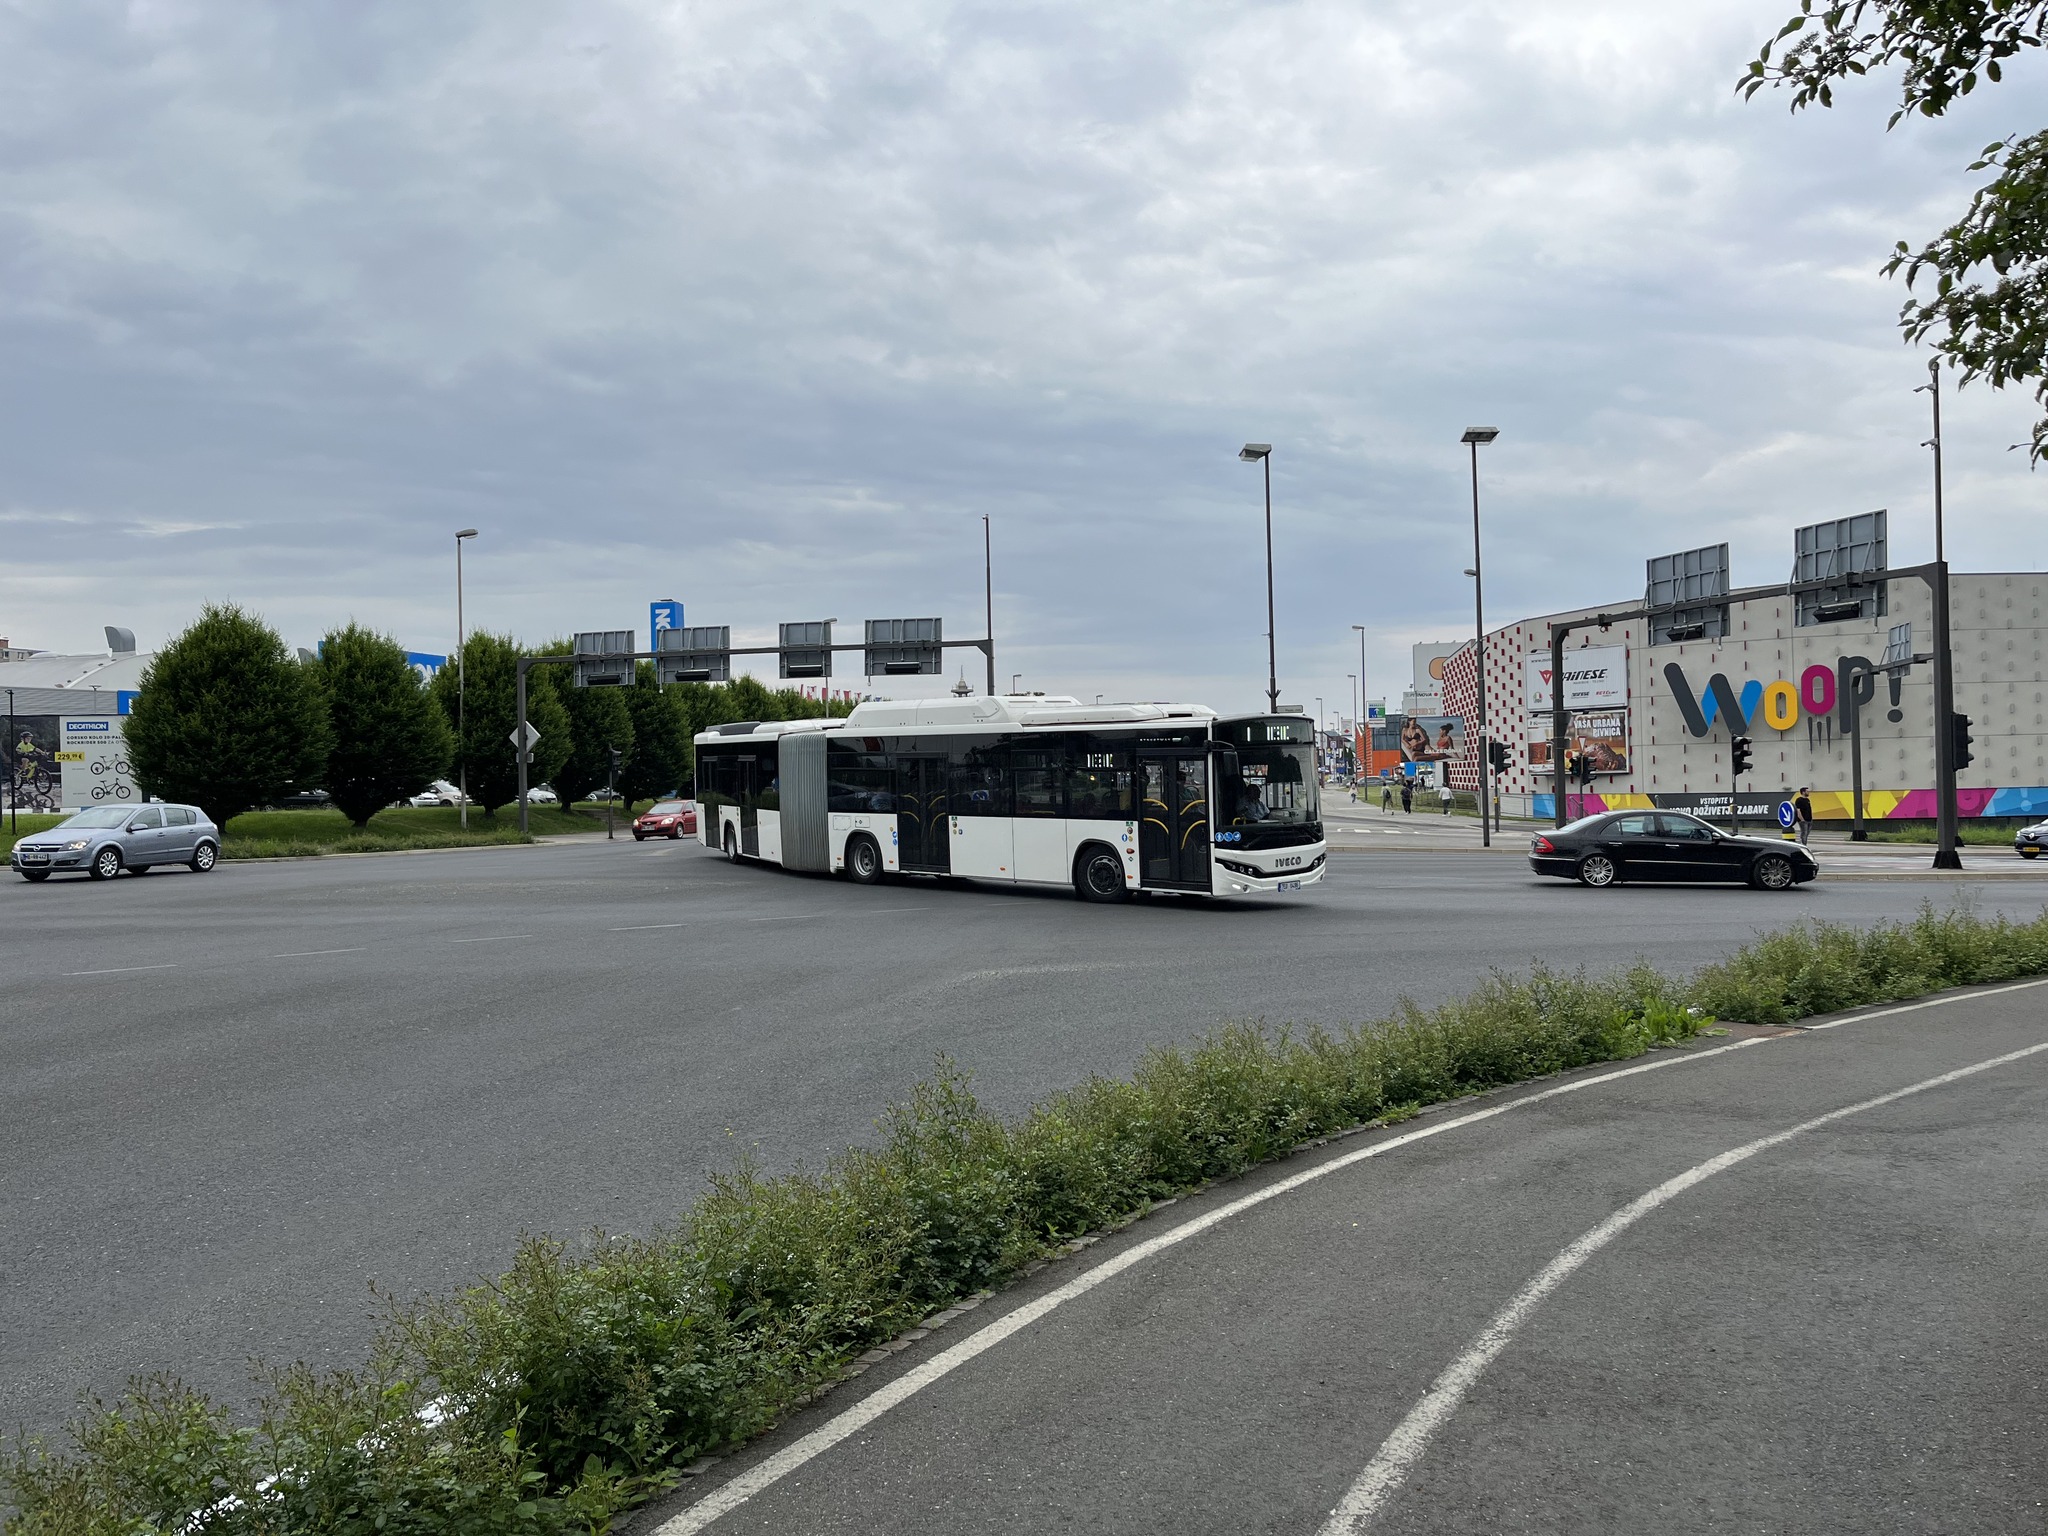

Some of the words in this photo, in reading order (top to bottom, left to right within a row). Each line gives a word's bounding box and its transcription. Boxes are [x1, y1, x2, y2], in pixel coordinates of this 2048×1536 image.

[1561, 668, 1608, 681] AINESE
[1592, 717, 1621, 728] URBANA
[1700, 796, 1728, 805] VSTOPITE
[1729, 796, 1734, 804] V
[1692, 804, 1734, 816] DOŽIVETJ
[1737, 804, 1769, 815] ZABAVE
[1275, 856, 1302, 867] IVECO
